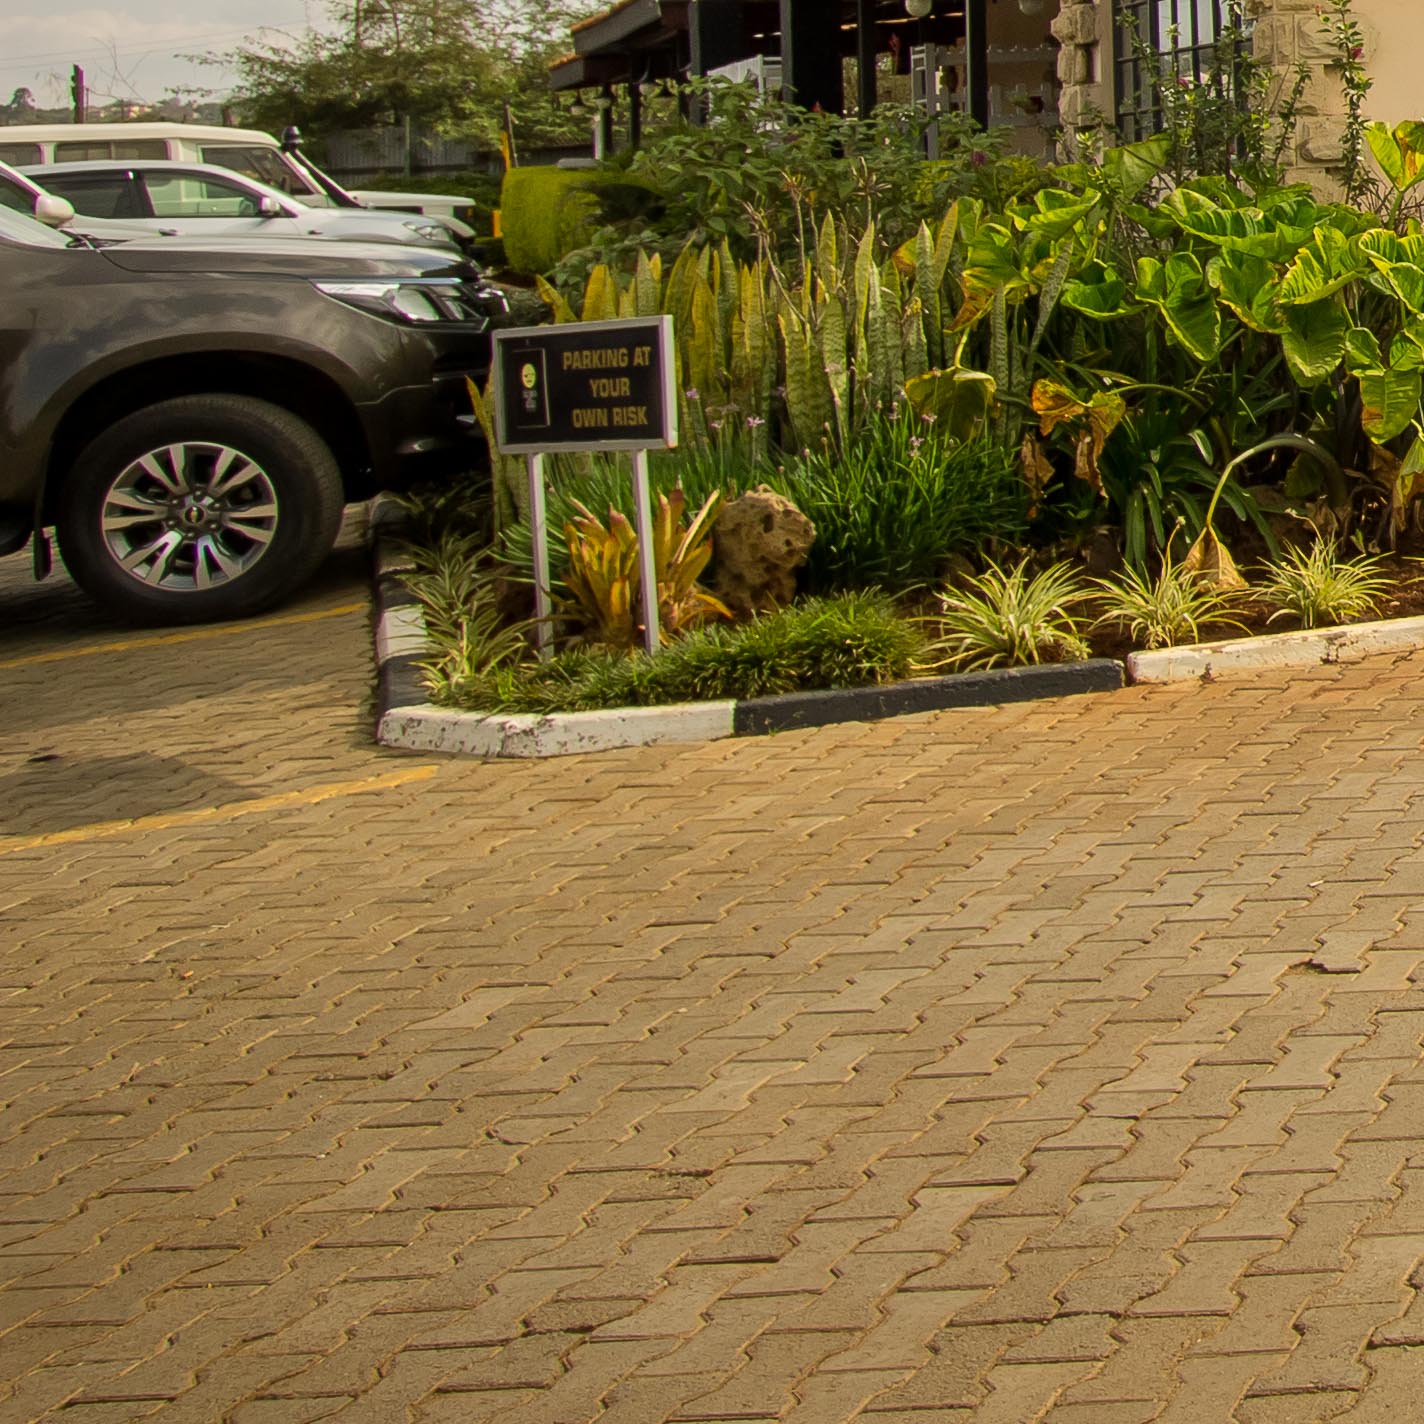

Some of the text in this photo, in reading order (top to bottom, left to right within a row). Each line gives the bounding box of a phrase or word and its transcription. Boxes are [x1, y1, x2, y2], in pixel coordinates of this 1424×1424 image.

[562, 346, 651, 370] PARKING AT
[589, 377, 631, 398] YOUR
[572, 406, 648, 429] OWN RISK
